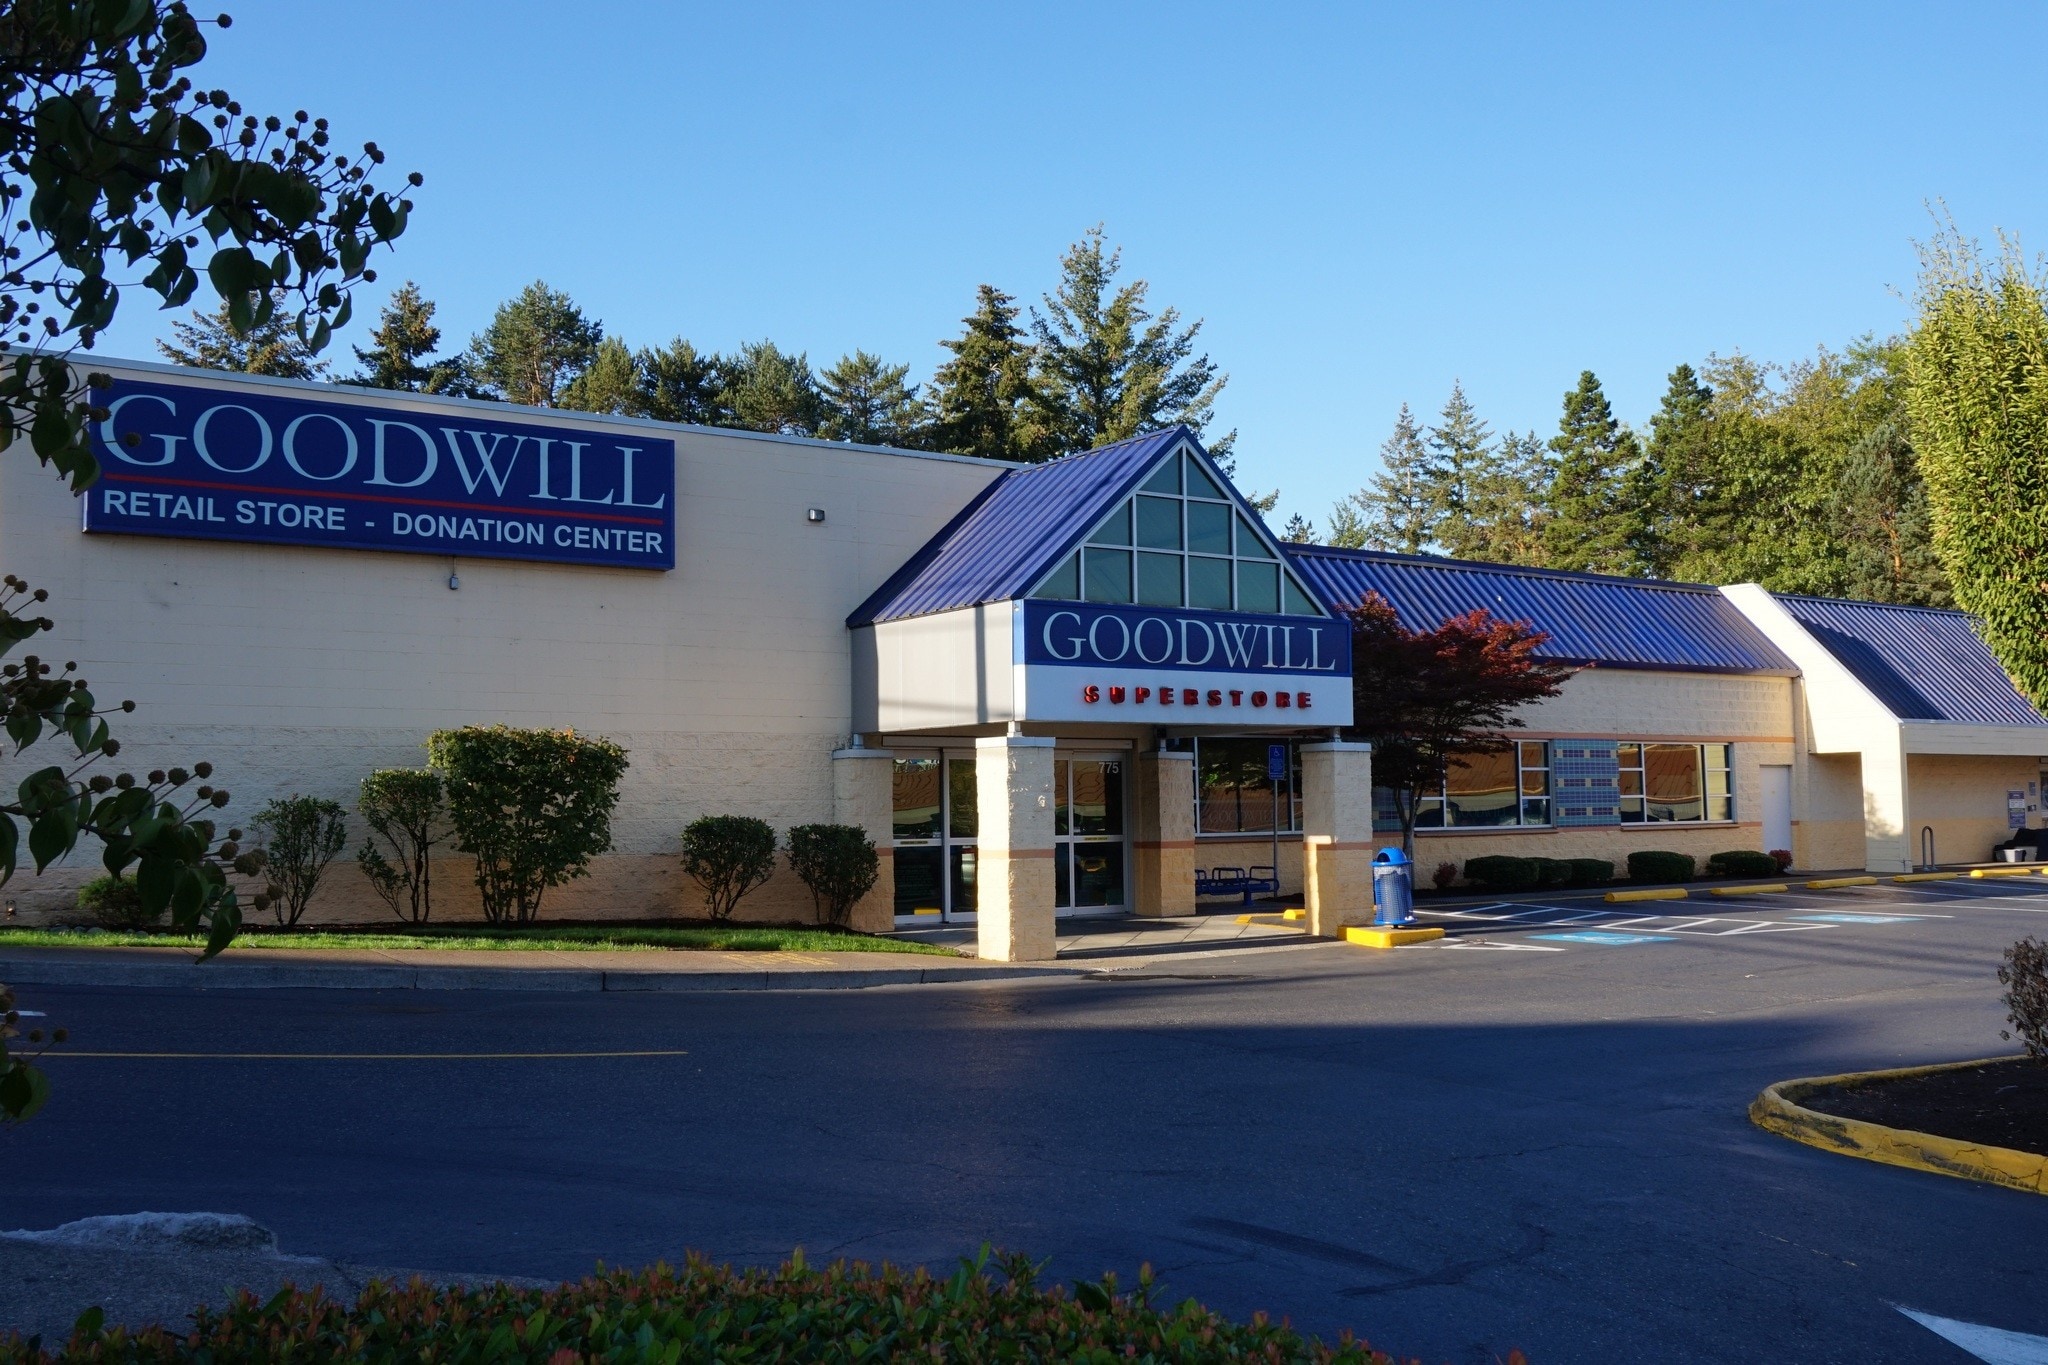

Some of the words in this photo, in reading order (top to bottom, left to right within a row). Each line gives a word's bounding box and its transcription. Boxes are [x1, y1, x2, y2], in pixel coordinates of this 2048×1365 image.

[101, 394, 665, 510] GOODWILL
[104, 489, 226, 523] RETAIL
[236, 500, 346, 531] STORE
[393, 512, 545, 546] DONATION
[554, 525, 663, 554] CENTER
[1043, 611, 1336, 671] GOODWILL
[1084, 685, 1312, 709] SUPERSTORE
[1098, 762, 1119, 774] 775
